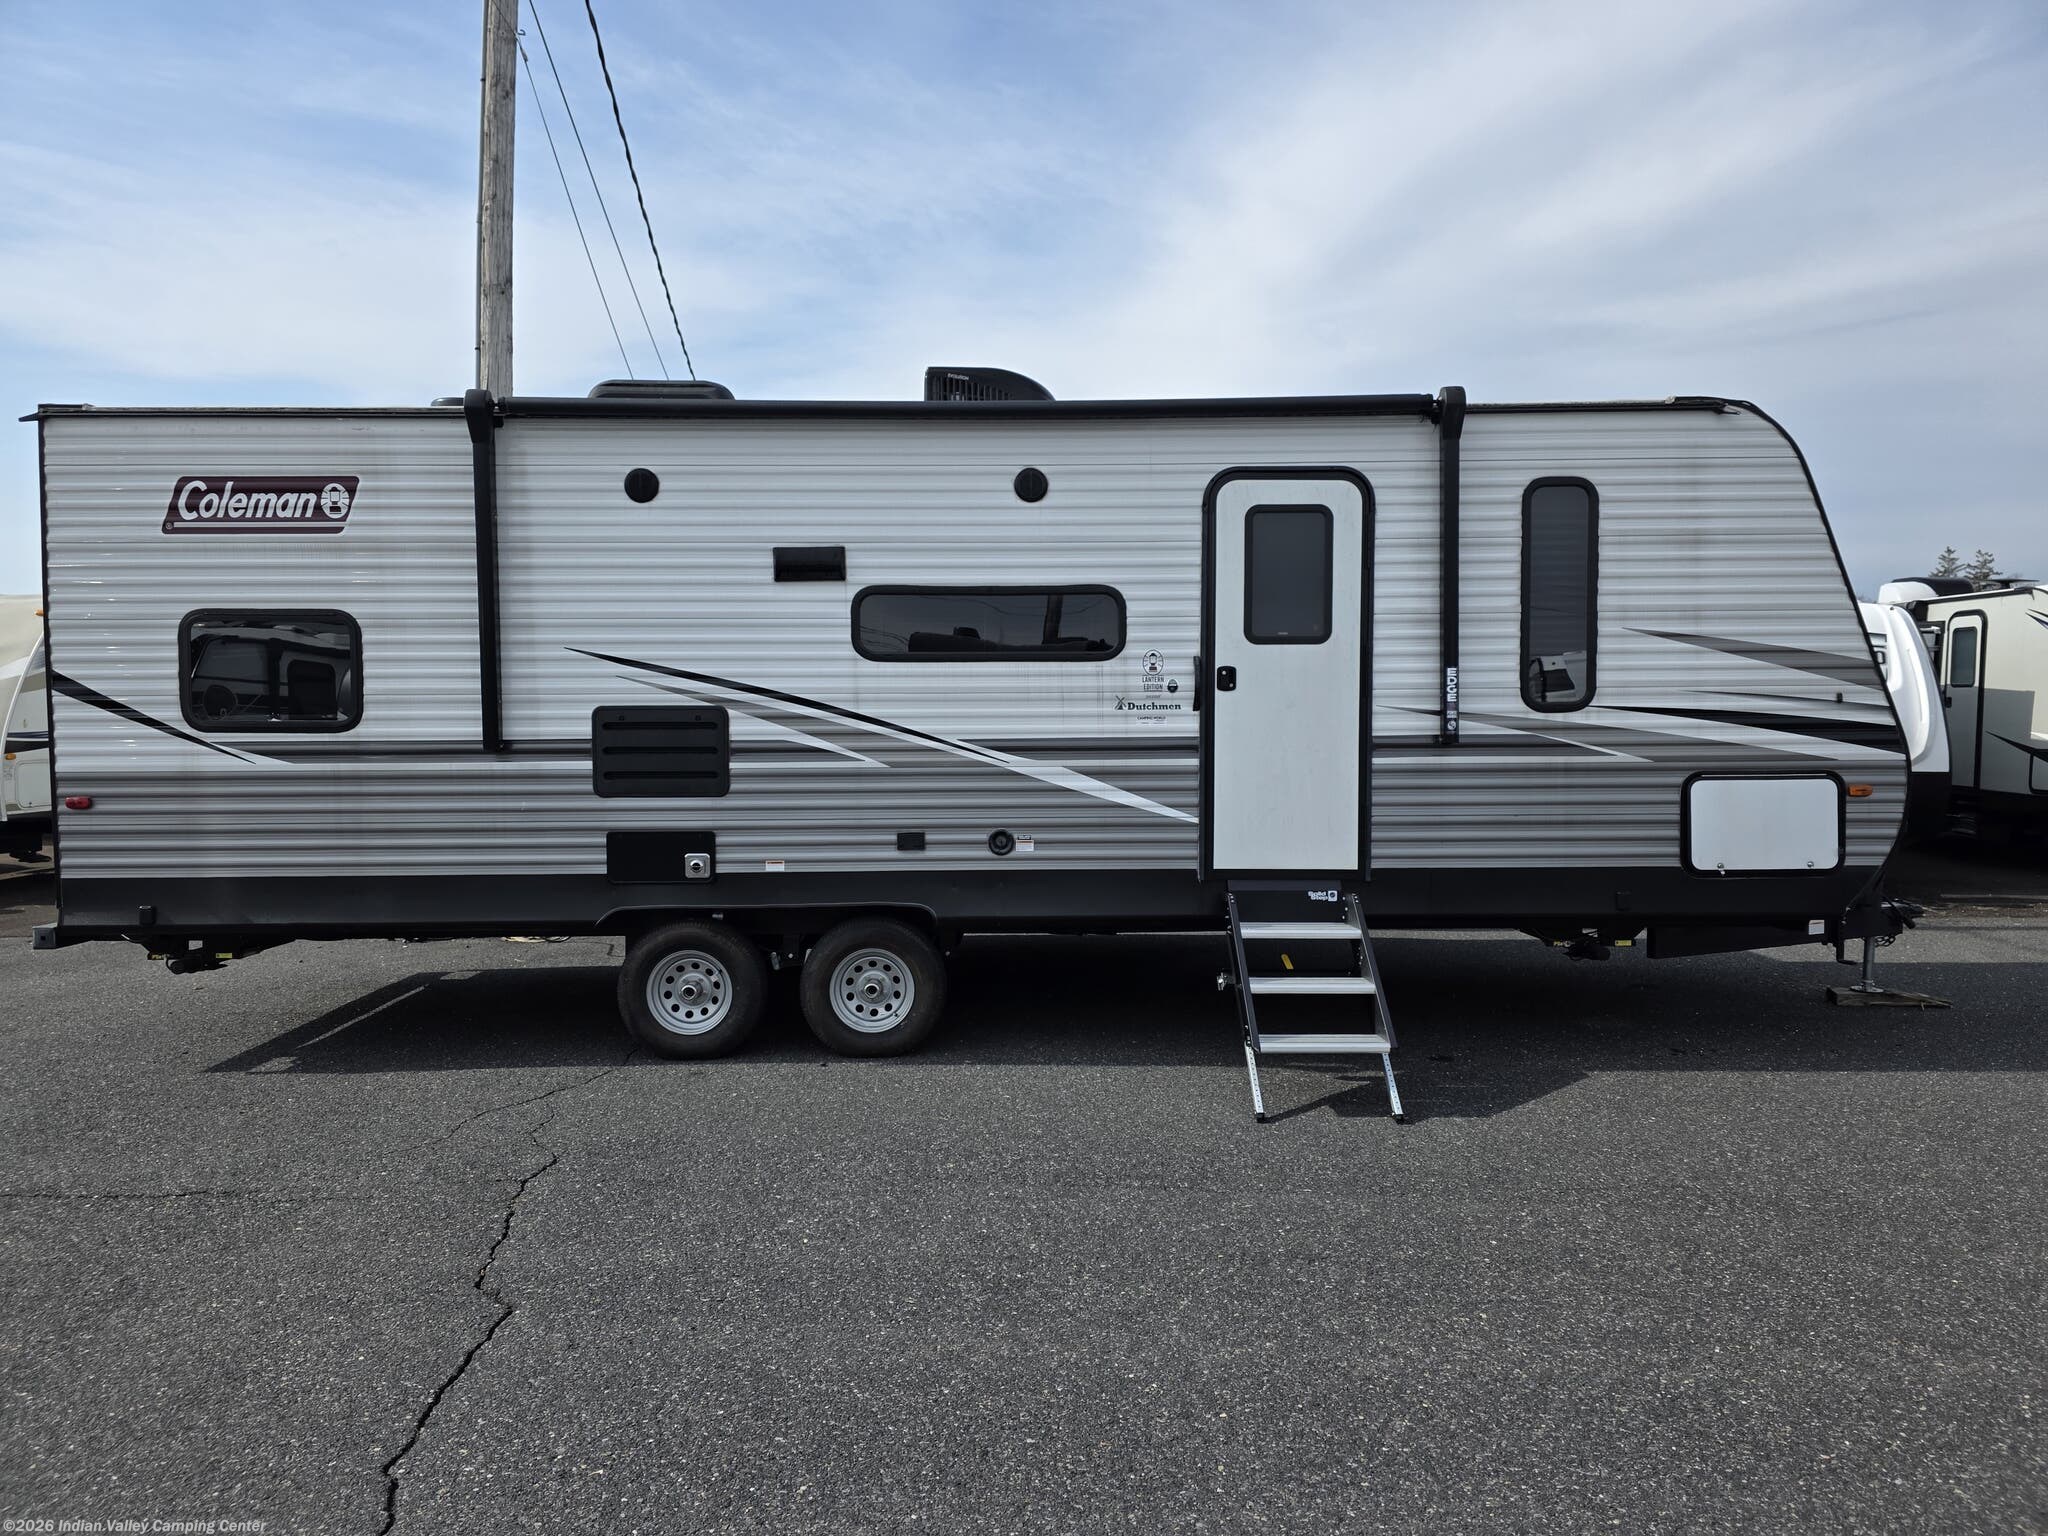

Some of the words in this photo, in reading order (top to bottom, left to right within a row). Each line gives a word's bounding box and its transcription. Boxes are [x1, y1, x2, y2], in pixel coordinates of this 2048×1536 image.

[177, 480, 317, 520] Coleman
[1447, 667, 1457, 702] EDGE
[1127, 701, 1182, 711] Dutchmen
